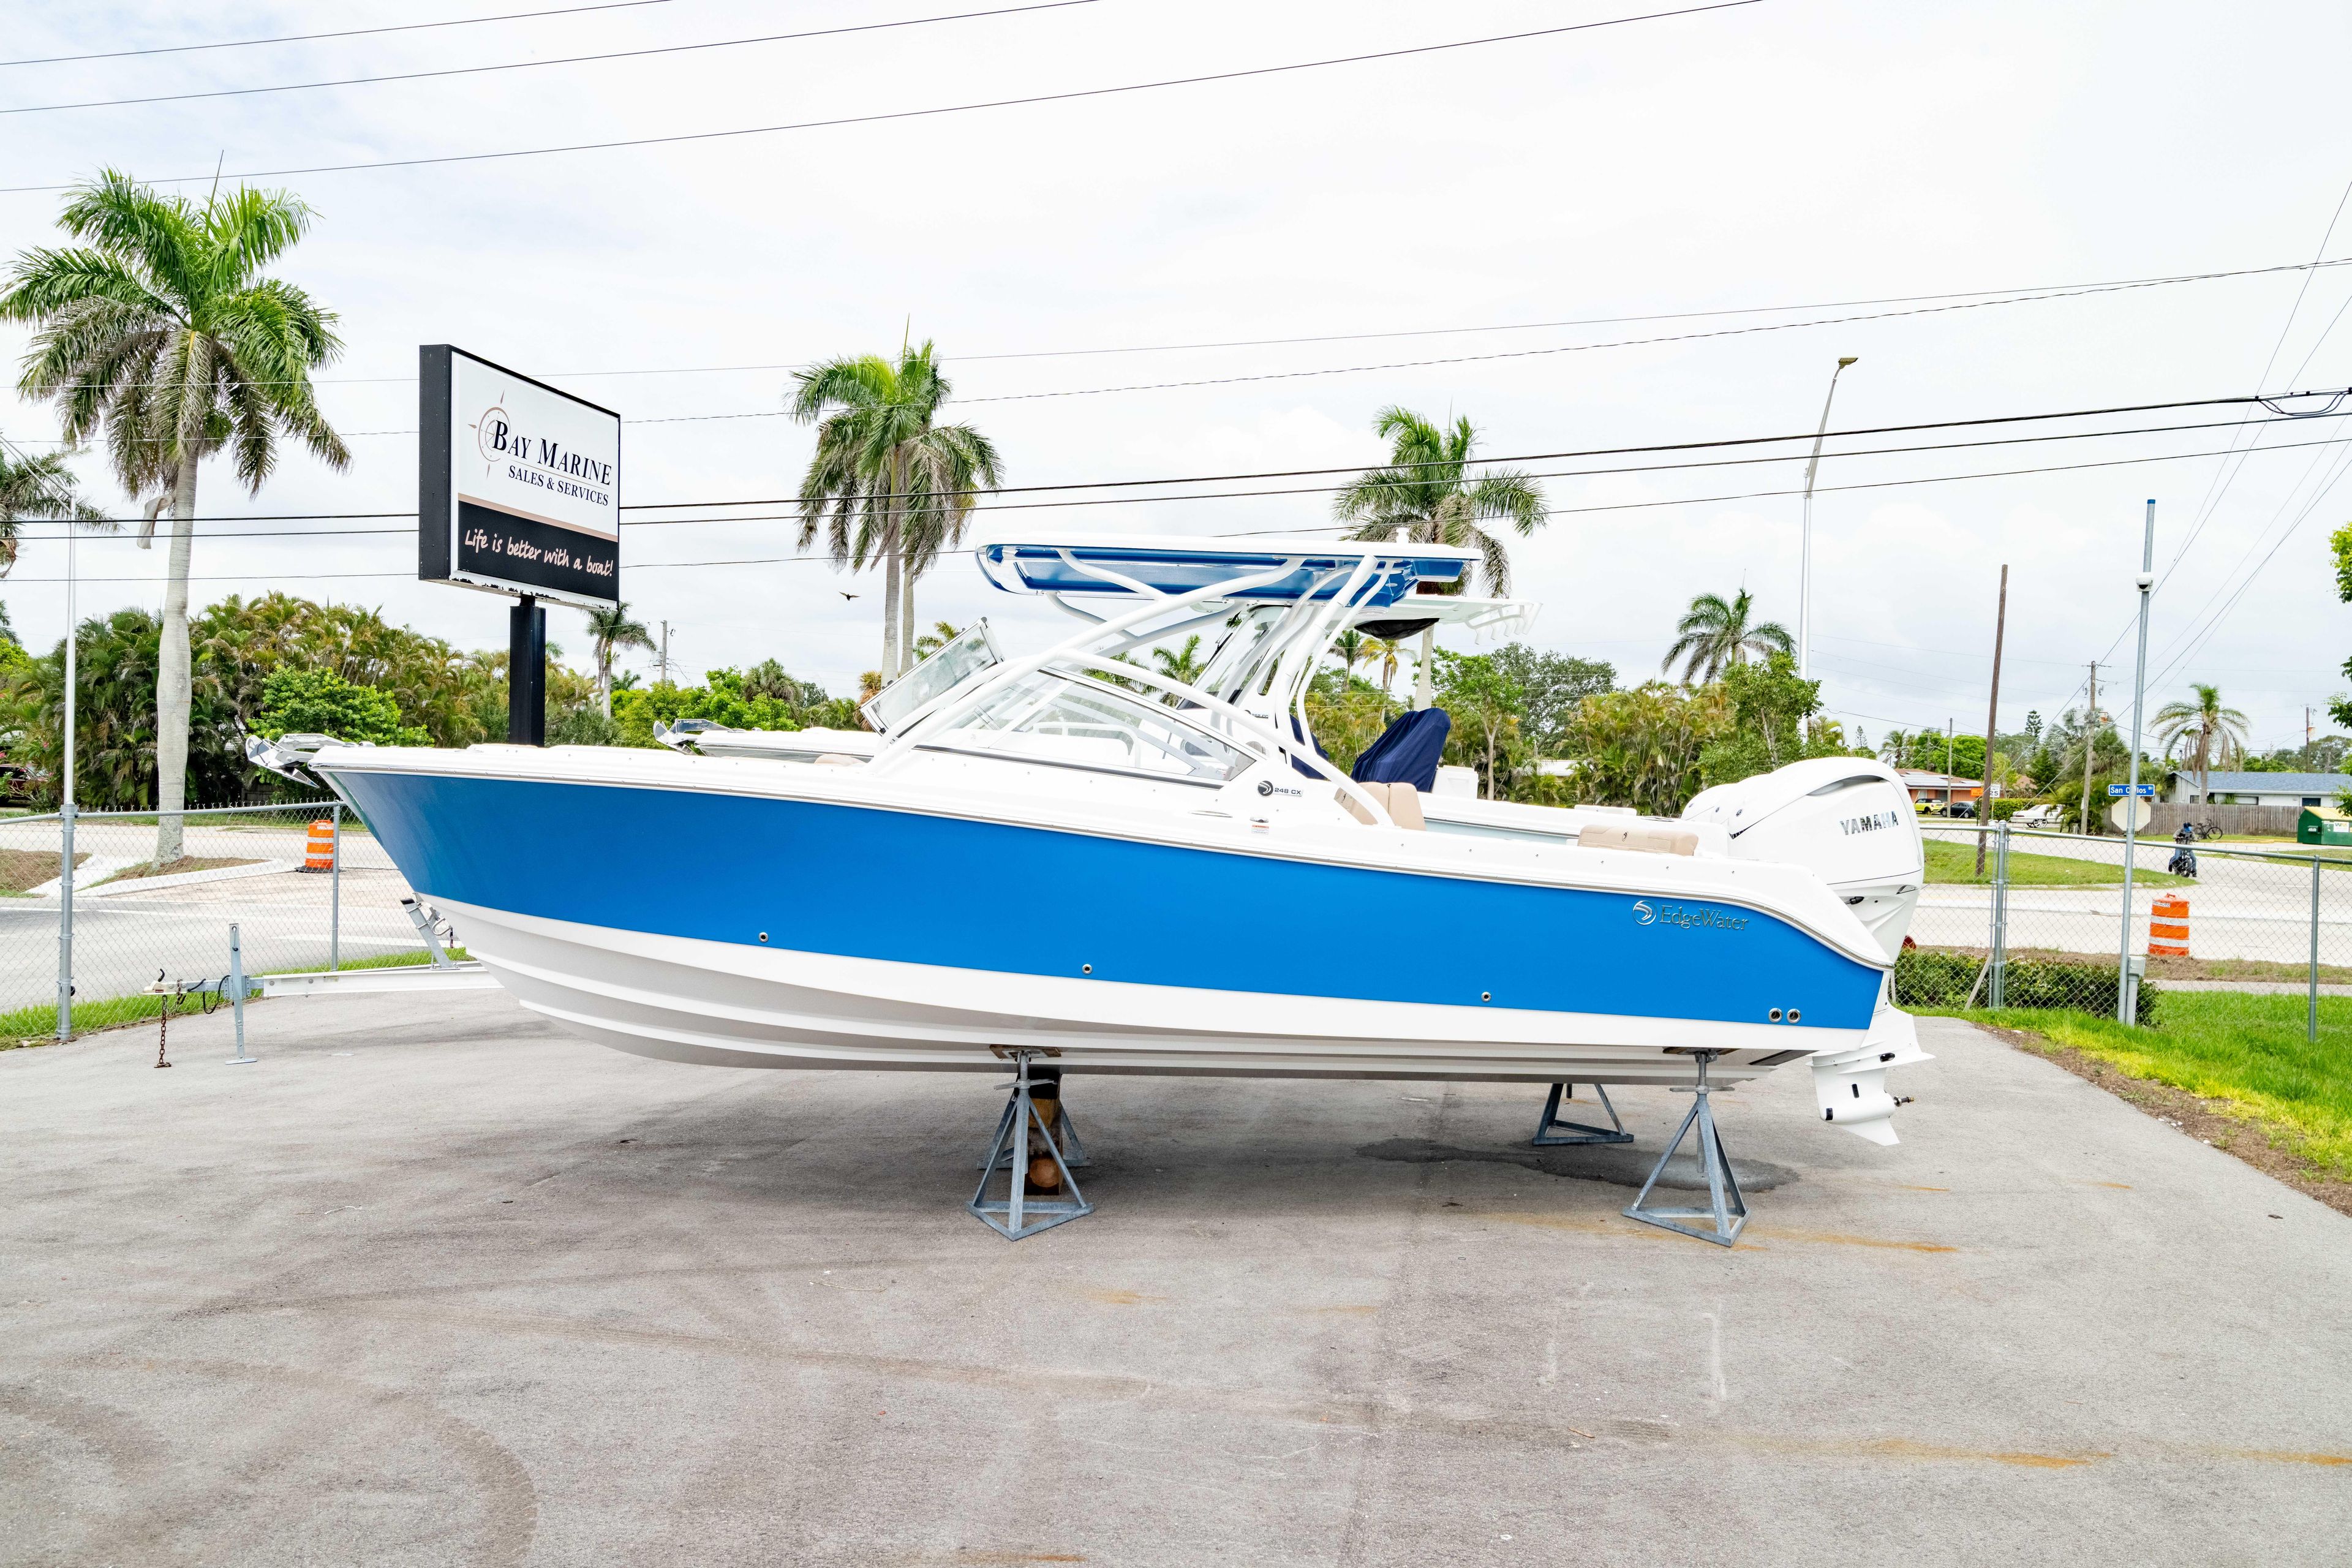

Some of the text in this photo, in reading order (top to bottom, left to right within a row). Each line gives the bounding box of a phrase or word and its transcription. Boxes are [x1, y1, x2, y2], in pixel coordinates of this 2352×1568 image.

[491, 420, 612, 486] BAY MARINE
[508, 465, 609, 507] SALES & SERVICES
[464, 529, 613, 577] Life is better with a boat!
[1839, 810, 1899, 835] YAMAHA
[1659, 905, 1749, 931] EdgeWater
